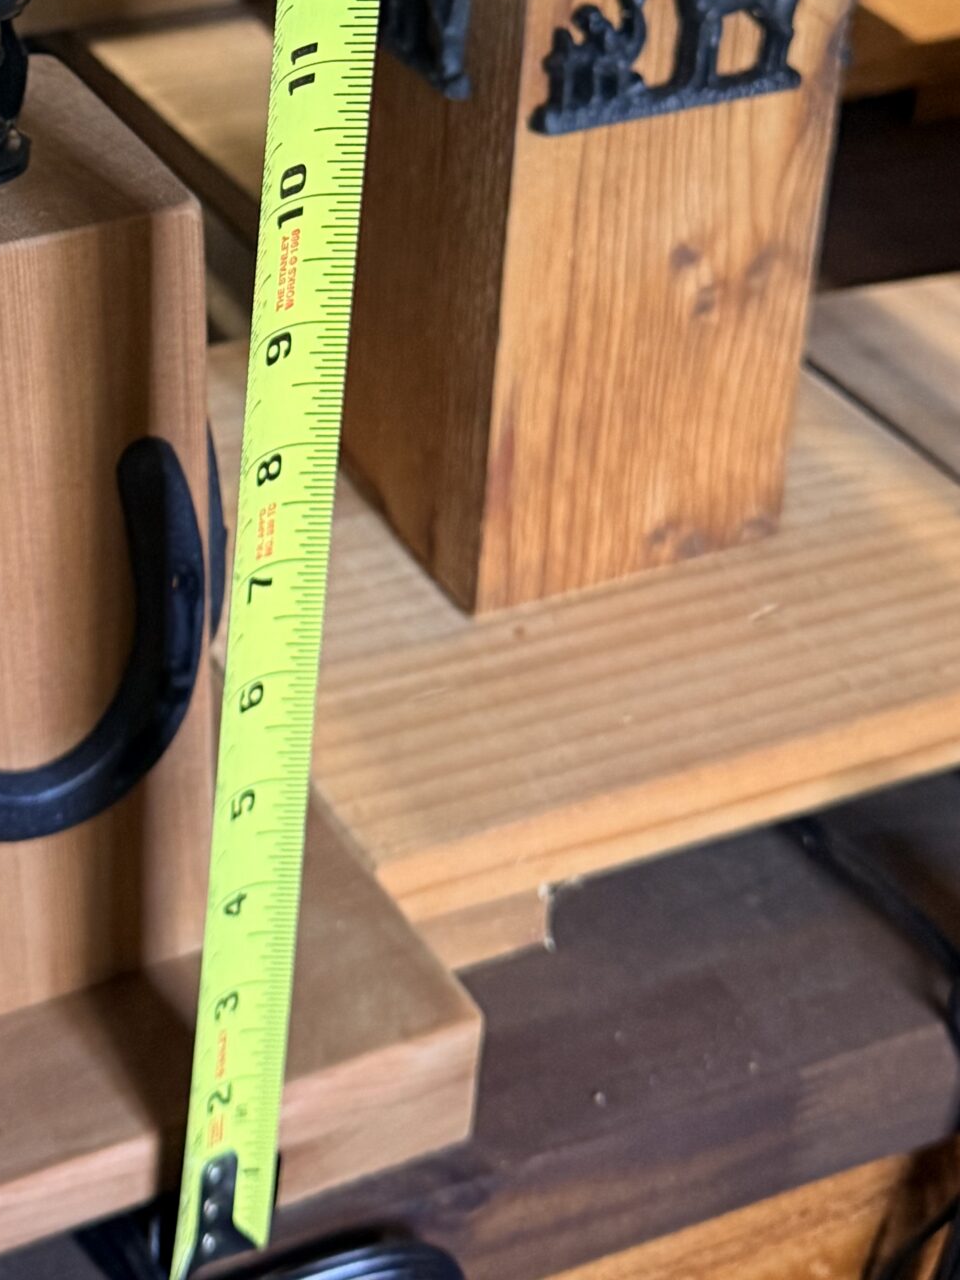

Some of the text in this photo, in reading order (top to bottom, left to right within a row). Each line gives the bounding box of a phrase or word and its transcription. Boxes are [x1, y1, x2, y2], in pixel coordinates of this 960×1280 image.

[288, 42, 319, 96] 11
[278, 163, 307, 230] 10
[276, 236, 289, 312] THE STANLEY
[285, 267, 296, 310] WORKS
[265, 331, 292, 367] 9
[257, 452, 282, 487] 8
[247, 576, 272, 604] 7
[240, 681, 264, 714] 6
[230, 789, 256, 821] 5
[224, 892, 247, 917] 4
[215, 990, 238, 1022] 3
[206, 1081, 232, 1114] 2
